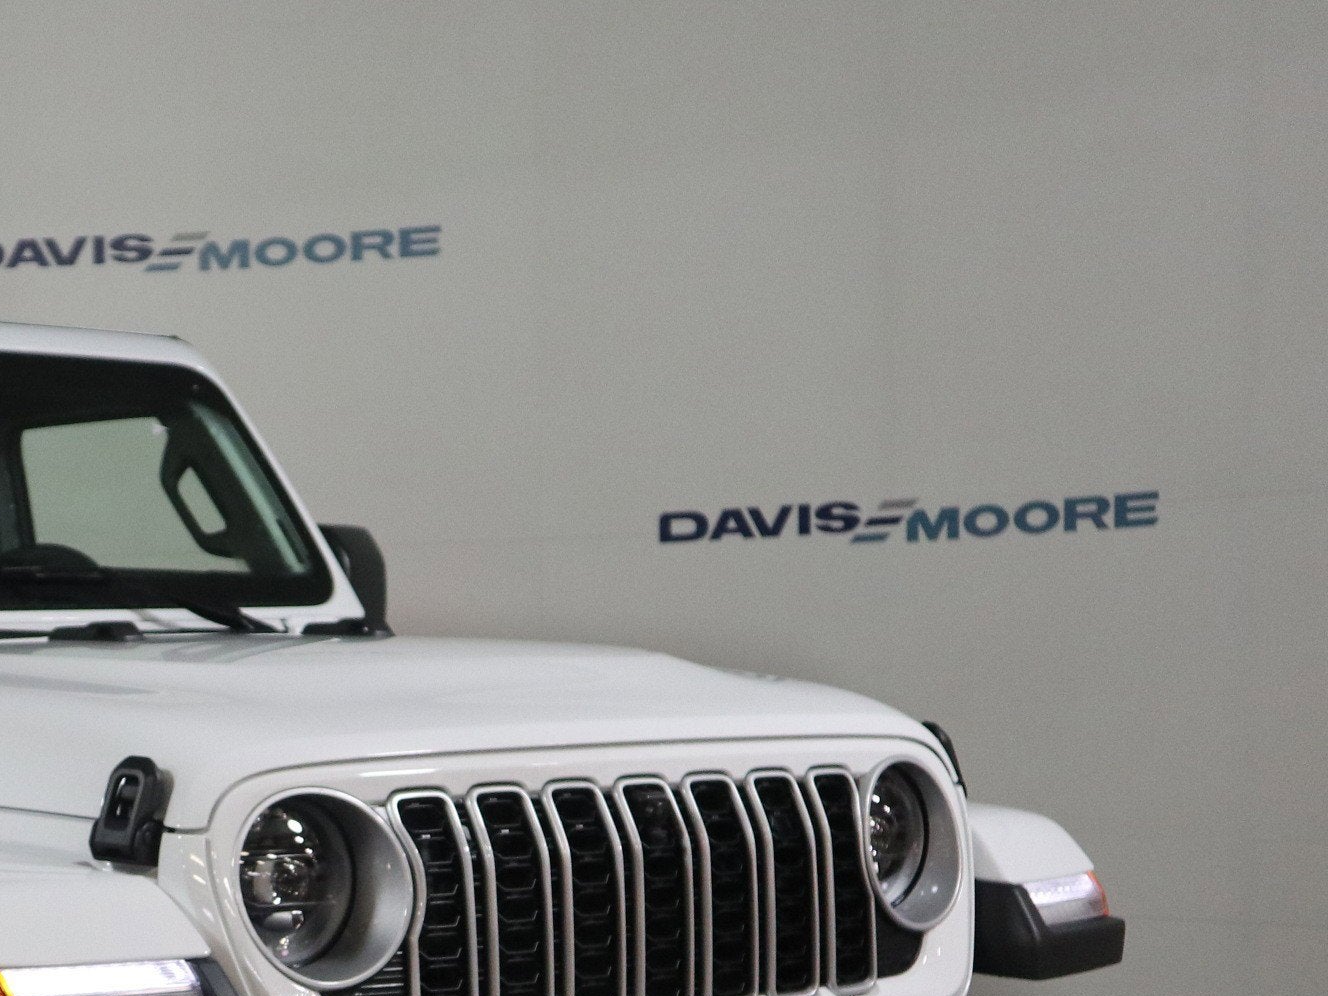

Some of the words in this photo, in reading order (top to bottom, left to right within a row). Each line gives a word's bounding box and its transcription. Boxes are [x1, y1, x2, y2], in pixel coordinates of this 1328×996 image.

[197, 225, 442, 272] MOORE
[658, 501, 861, 544] DAVIS
[905, 490, 1161, 542] MOORE
